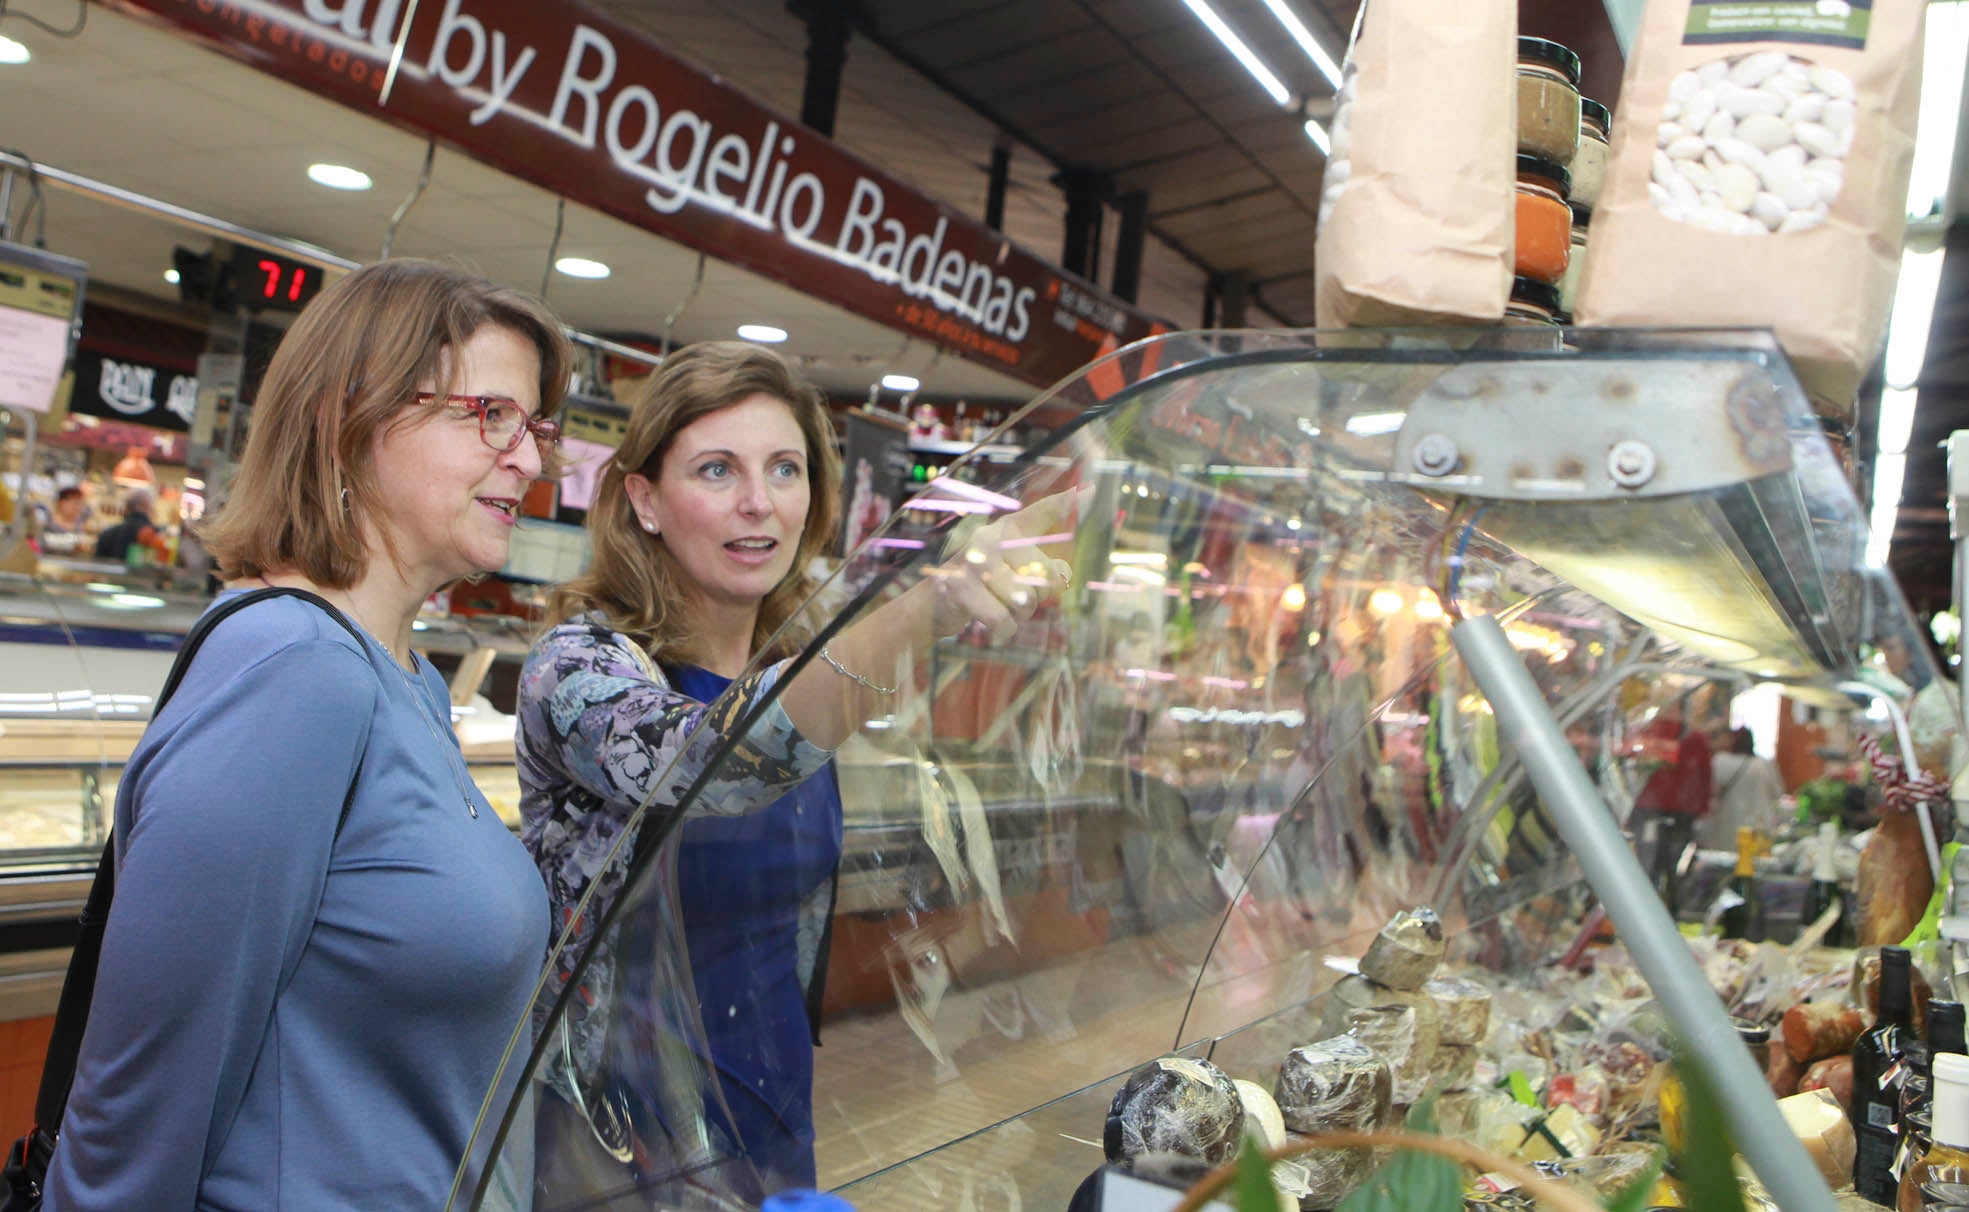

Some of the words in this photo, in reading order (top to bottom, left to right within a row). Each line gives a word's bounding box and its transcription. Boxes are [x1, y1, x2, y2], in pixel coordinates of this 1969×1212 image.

[427, 0, 537, 126] by
[549, 23, 825, 243] Rogelio
[836, 177, 1037, 343] Badenas
[258, 259, 306, 303] 71
